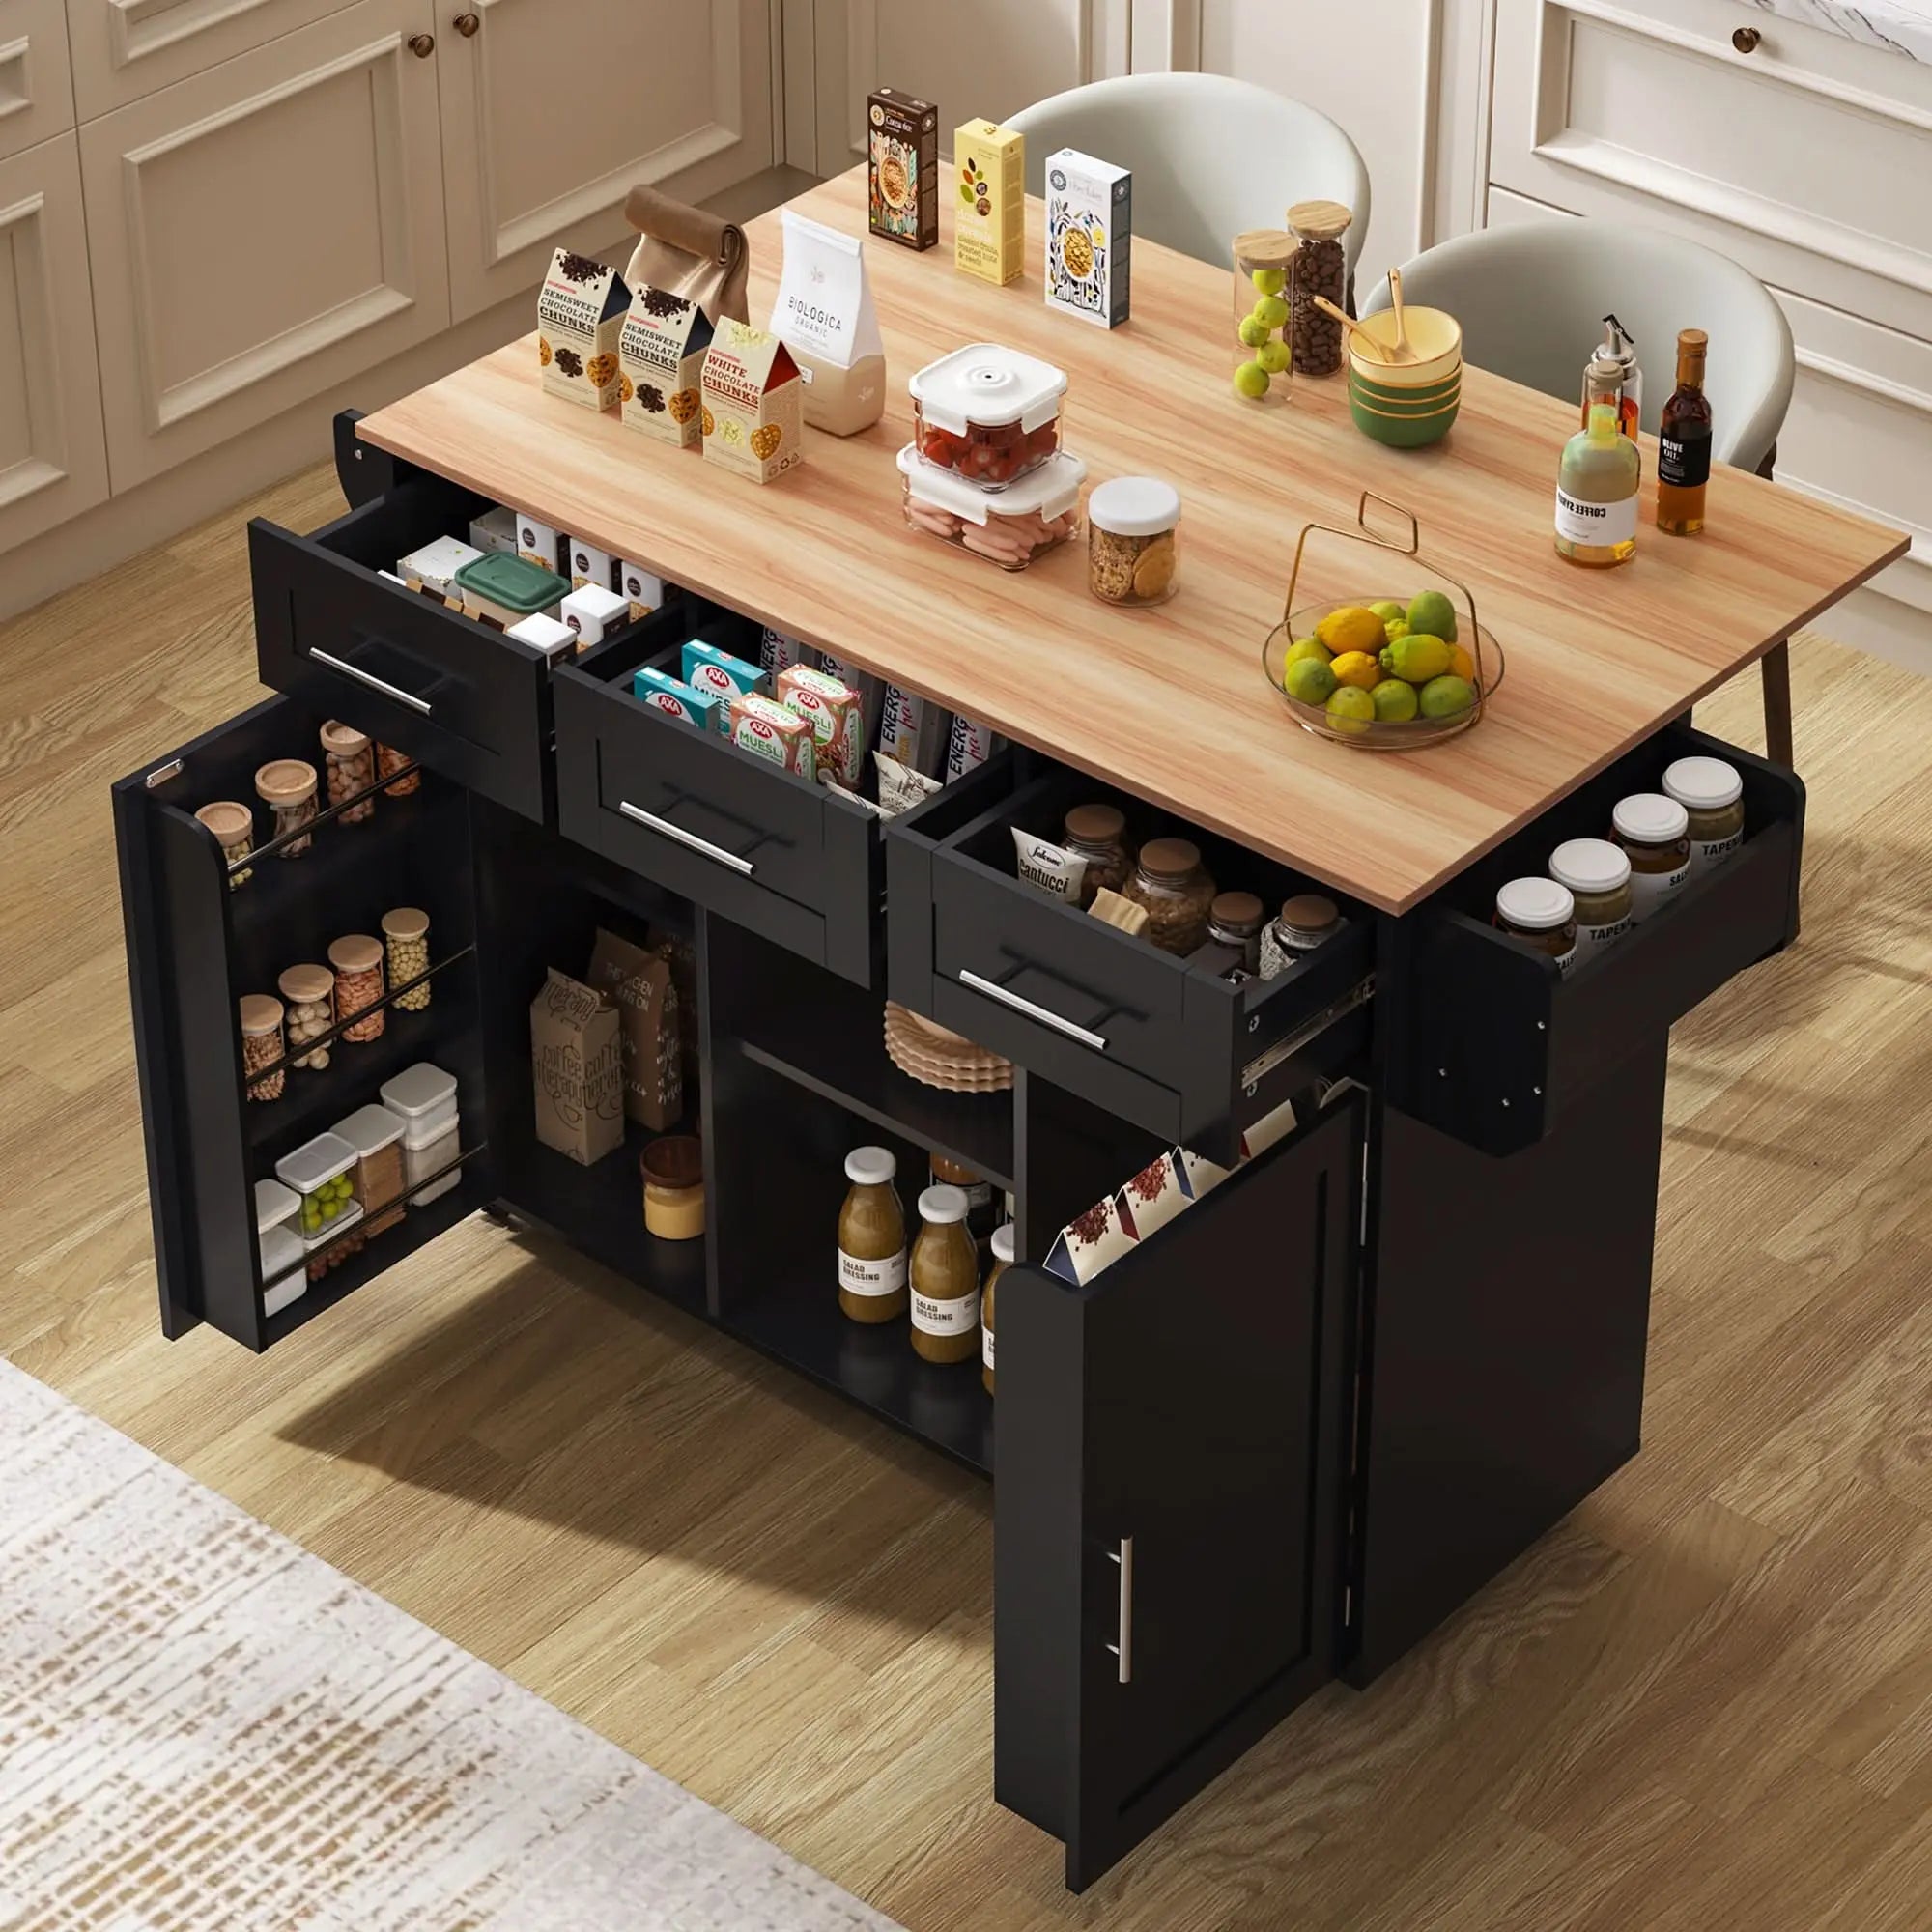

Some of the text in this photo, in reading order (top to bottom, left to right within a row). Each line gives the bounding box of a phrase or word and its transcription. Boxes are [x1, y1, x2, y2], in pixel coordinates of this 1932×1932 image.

[540, 298, 596, 324] CHOCOLATE
[543, 288, 600, 314] SEMISWEET
[788, 296, 841, 331] BIOLOGICA
[540, 306, 595, 334] CHUNKS
[795, 316, 828, 338] ORGANIC
[622, 332, 679, 358] CHOCOLATE
[626, 323, 682, 349] SEMISWEET
[621, 342, 677, 369] CHUNKS
[708, 355, 748, 378] WHITE
[703, 375, 758, 405] CHUNKS
[704, 365, 760, 394] CHOCOLATE
[1662, 438, 1683, 453] OLIVE
[707, 668, 728, 687] AXA
[661, 696, 681, 714] AXA
[883, 685, 901, 744] ENERG
[739, 730, 782, 759] MUESLI
[950, 715, 967, 775] ENERG
[1019, 858, 1069, 894] Cantucci
[842, 1259, 866, 1273] SALAD
[842, 1265, 880, 1281] DRESSING
[915, 1297, 938, 1312] SALAD
[916, 1306, 952, 1321] DRESSING
